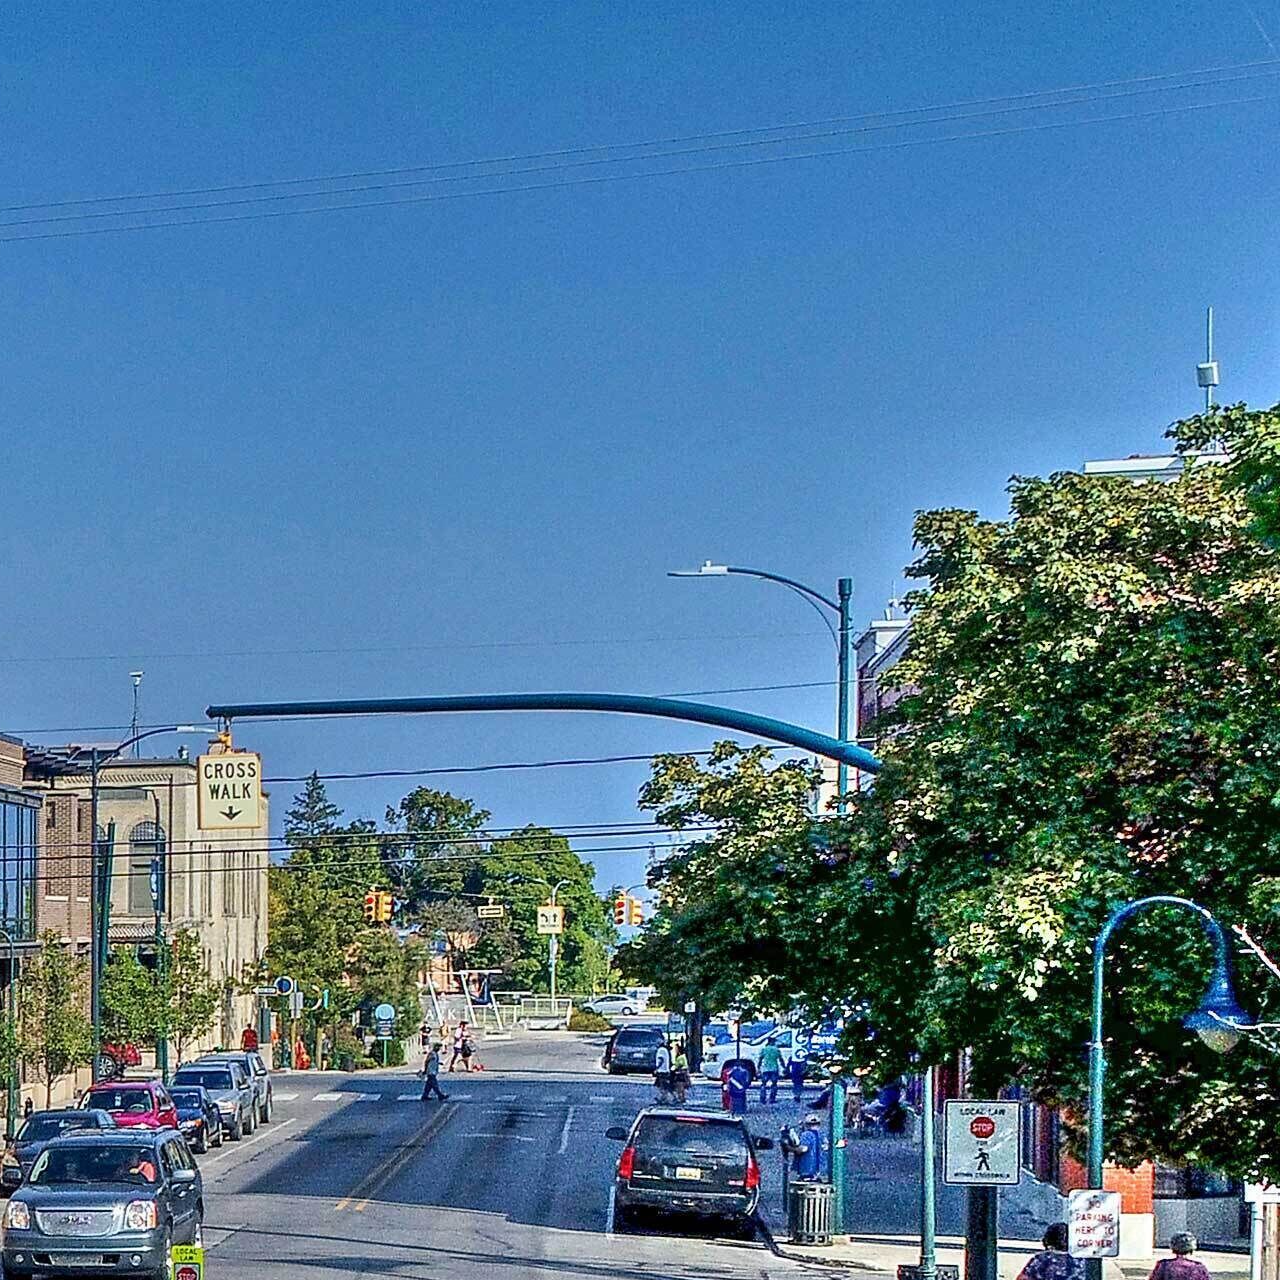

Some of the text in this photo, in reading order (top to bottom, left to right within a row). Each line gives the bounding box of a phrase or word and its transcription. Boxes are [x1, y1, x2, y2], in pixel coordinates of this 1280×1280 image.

[204, 762, 257, 779] CROSS
[209, 783, 251, 799] WALK
[960, 1108, 1006, 1116] LOCAL LAW
[972, 1123, 994, 1132] STOP
[1075, 1213, 1114, 1222] PARKING
[1075, 1226, 1115, 1236] HERE TO
[1077, 1239, 1113, 1248] CORNER
